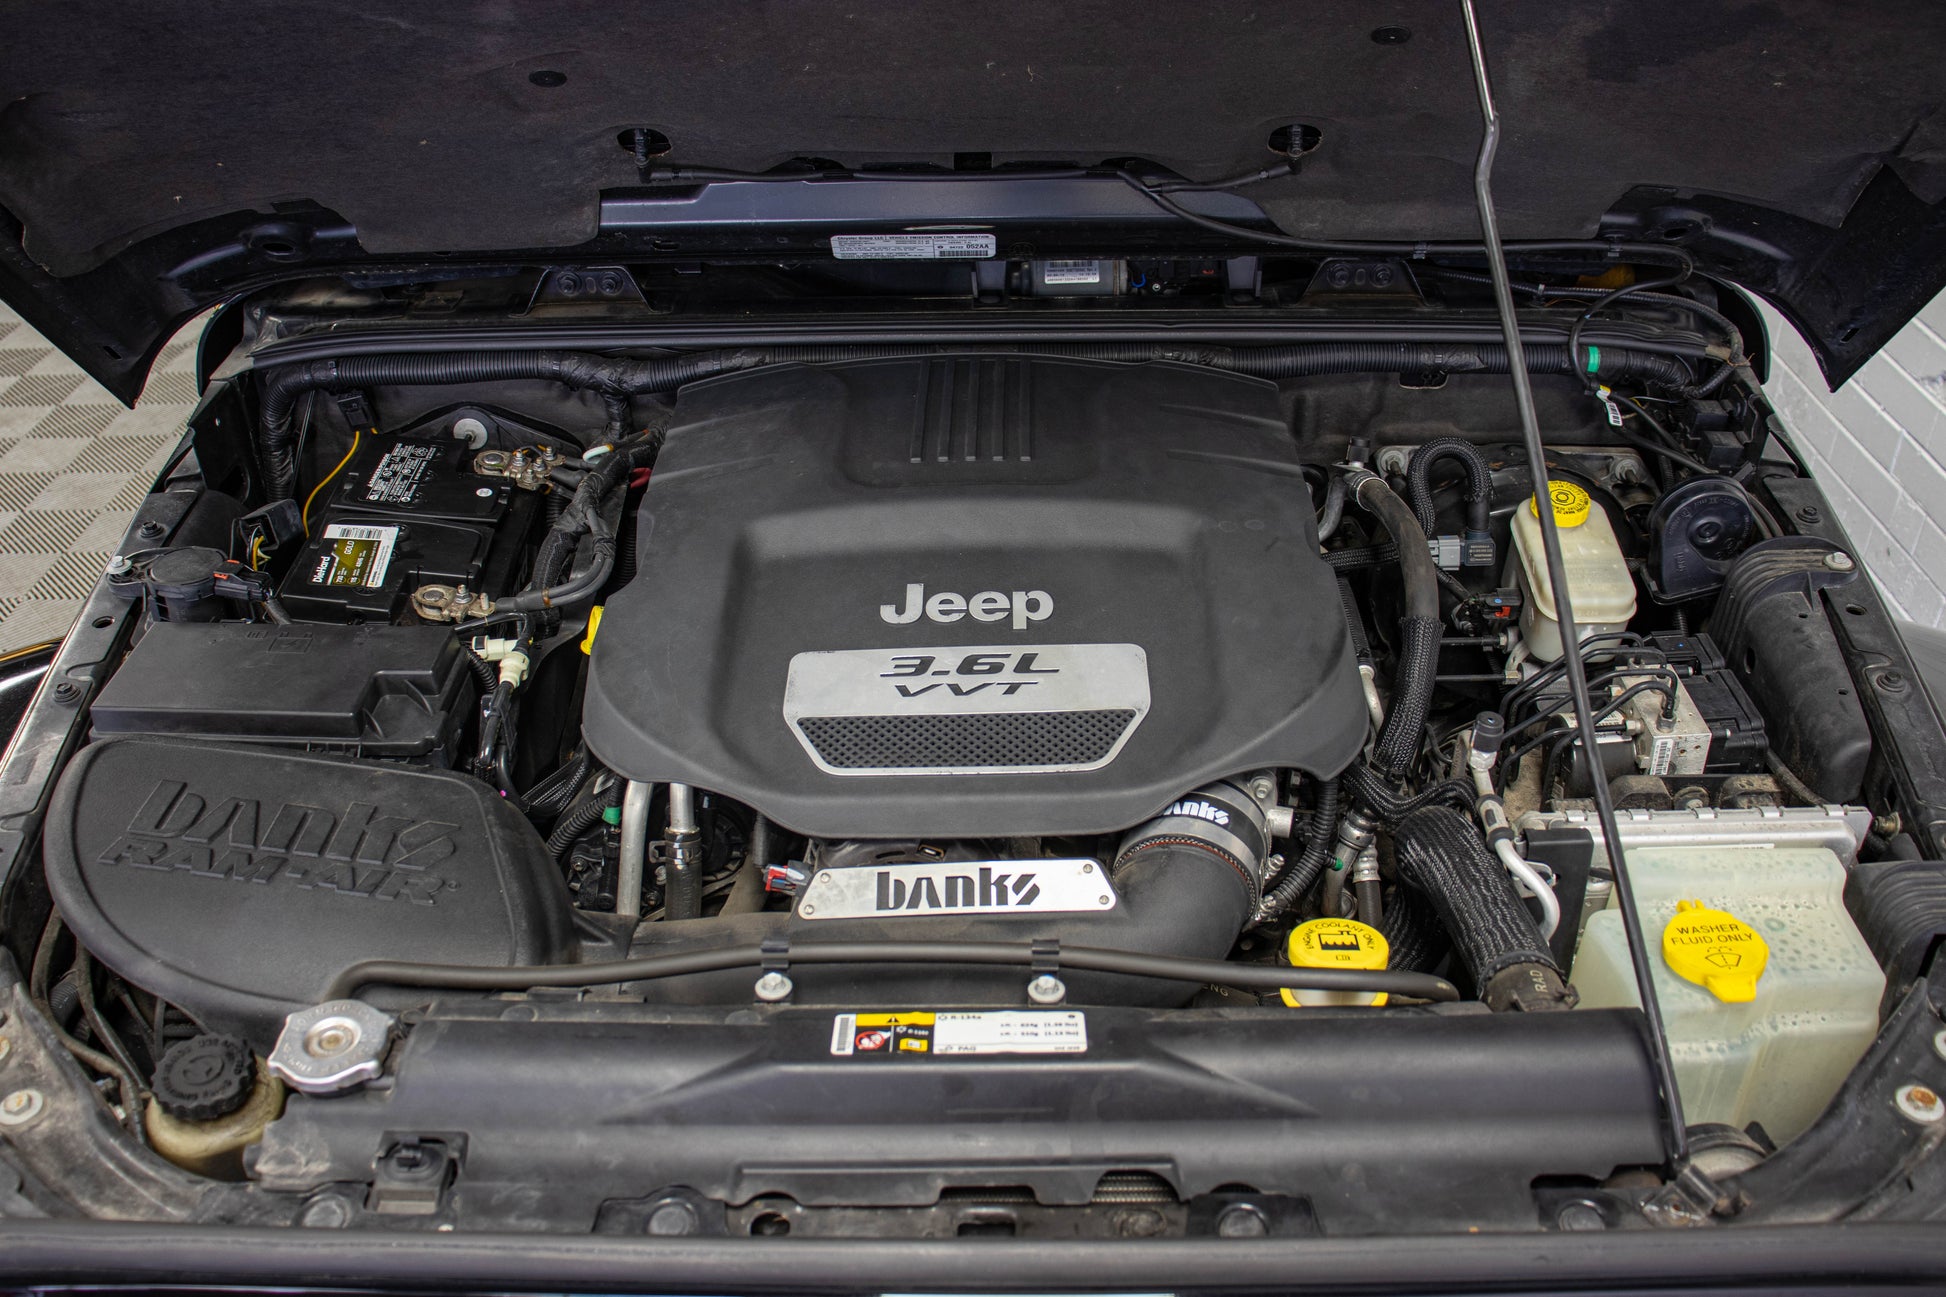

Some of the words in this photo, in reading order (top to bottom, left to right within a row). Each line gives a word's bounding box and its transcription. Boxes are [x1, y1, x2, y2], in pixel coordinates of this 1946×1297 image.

[344, 540, 355, 555] GOLD
[312, 556, 331, 583] DieHard
[880, 583, 1054, 630] Jeep
[879, 652, 1060, 677] 3.6L
[894, 681, 1039, 698] VVT
[127, 779, 461, 871] banks
[1163, 801, 1230, 826] anks
[876, 867, 1041, 911] banks
[1314, 921, 1364, 933] COOLANT
[1362, 934, 1375, 950] ONLY
[1671, 935, 1713, 945] FLUID
[1717, 933, 1753, 943] ONLY
[1676, 924, 1740, 935] WASHER
